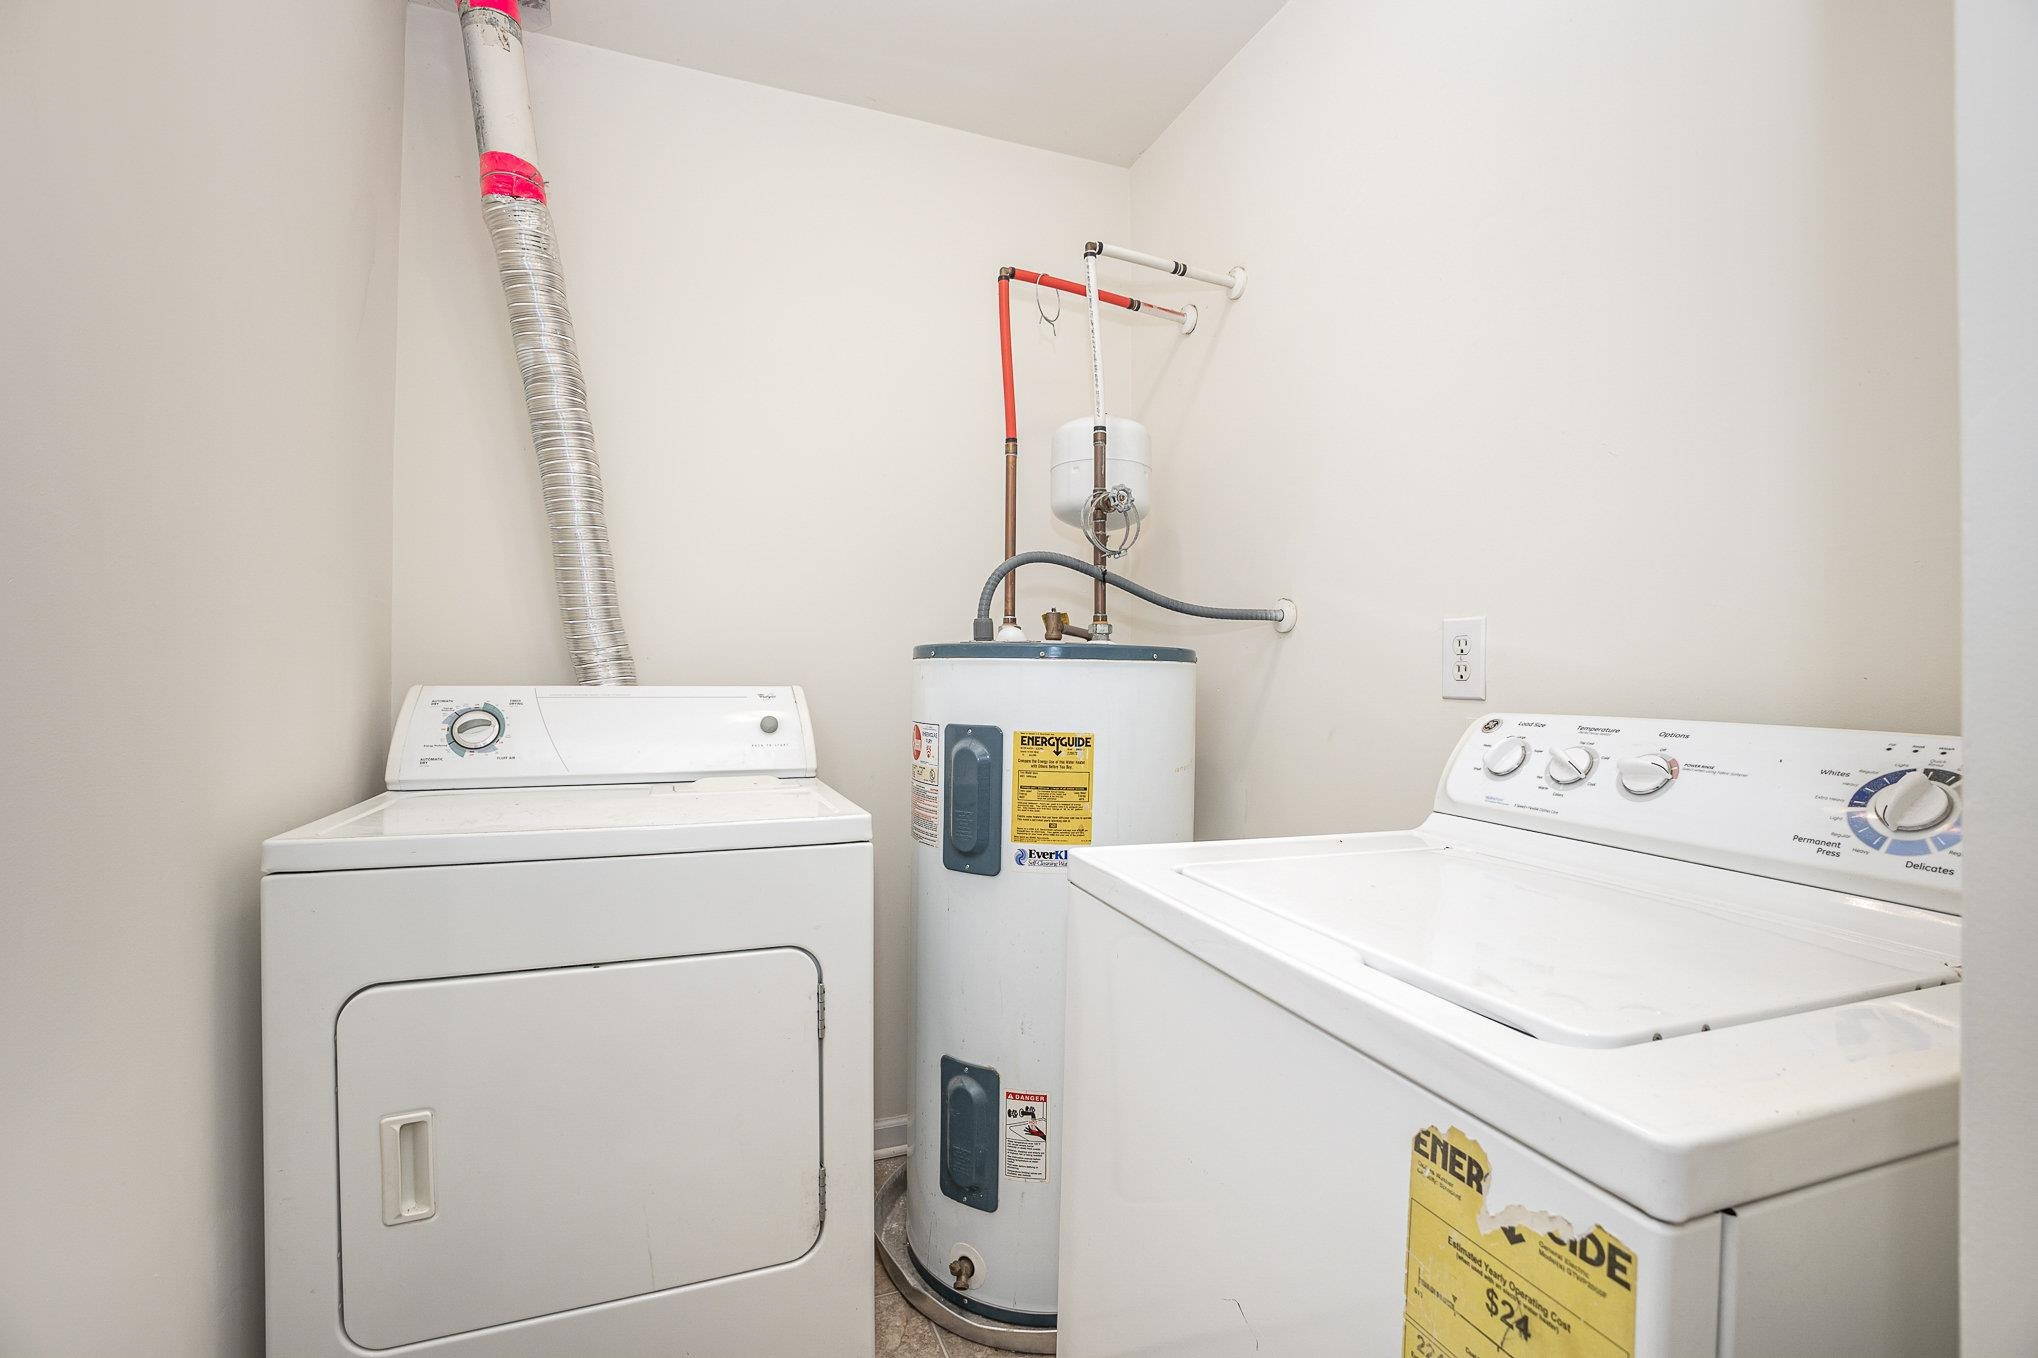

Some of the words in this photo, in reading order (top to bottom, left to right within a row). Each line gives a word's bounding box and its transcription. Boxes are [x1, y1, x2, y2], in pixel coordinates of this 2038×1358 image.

[1577, 725, 1621, 734] Temperature
[1658, 731, 1691, 740] Options
[1020, 735, 1092, 748] ENERGYGUIDE
[1820, 769, 1851, 778] Whites
[1792, 834, 1842, 849] Permanent
[1816, 847, 1841, 858] Press
[1905, 860, 1955, 876] Delicates
[1015, 1094, 1045, 1102] DANGER
[1448, 1235, 1483, 1268] Estimated
[1484, 1261, 1508, 1287] Yearly
[1508, 1280, 1549, 1319] Operating
[1550, 1311, 1572, 1335] Cost
[1485, 1287, 1532, 1342] $24
